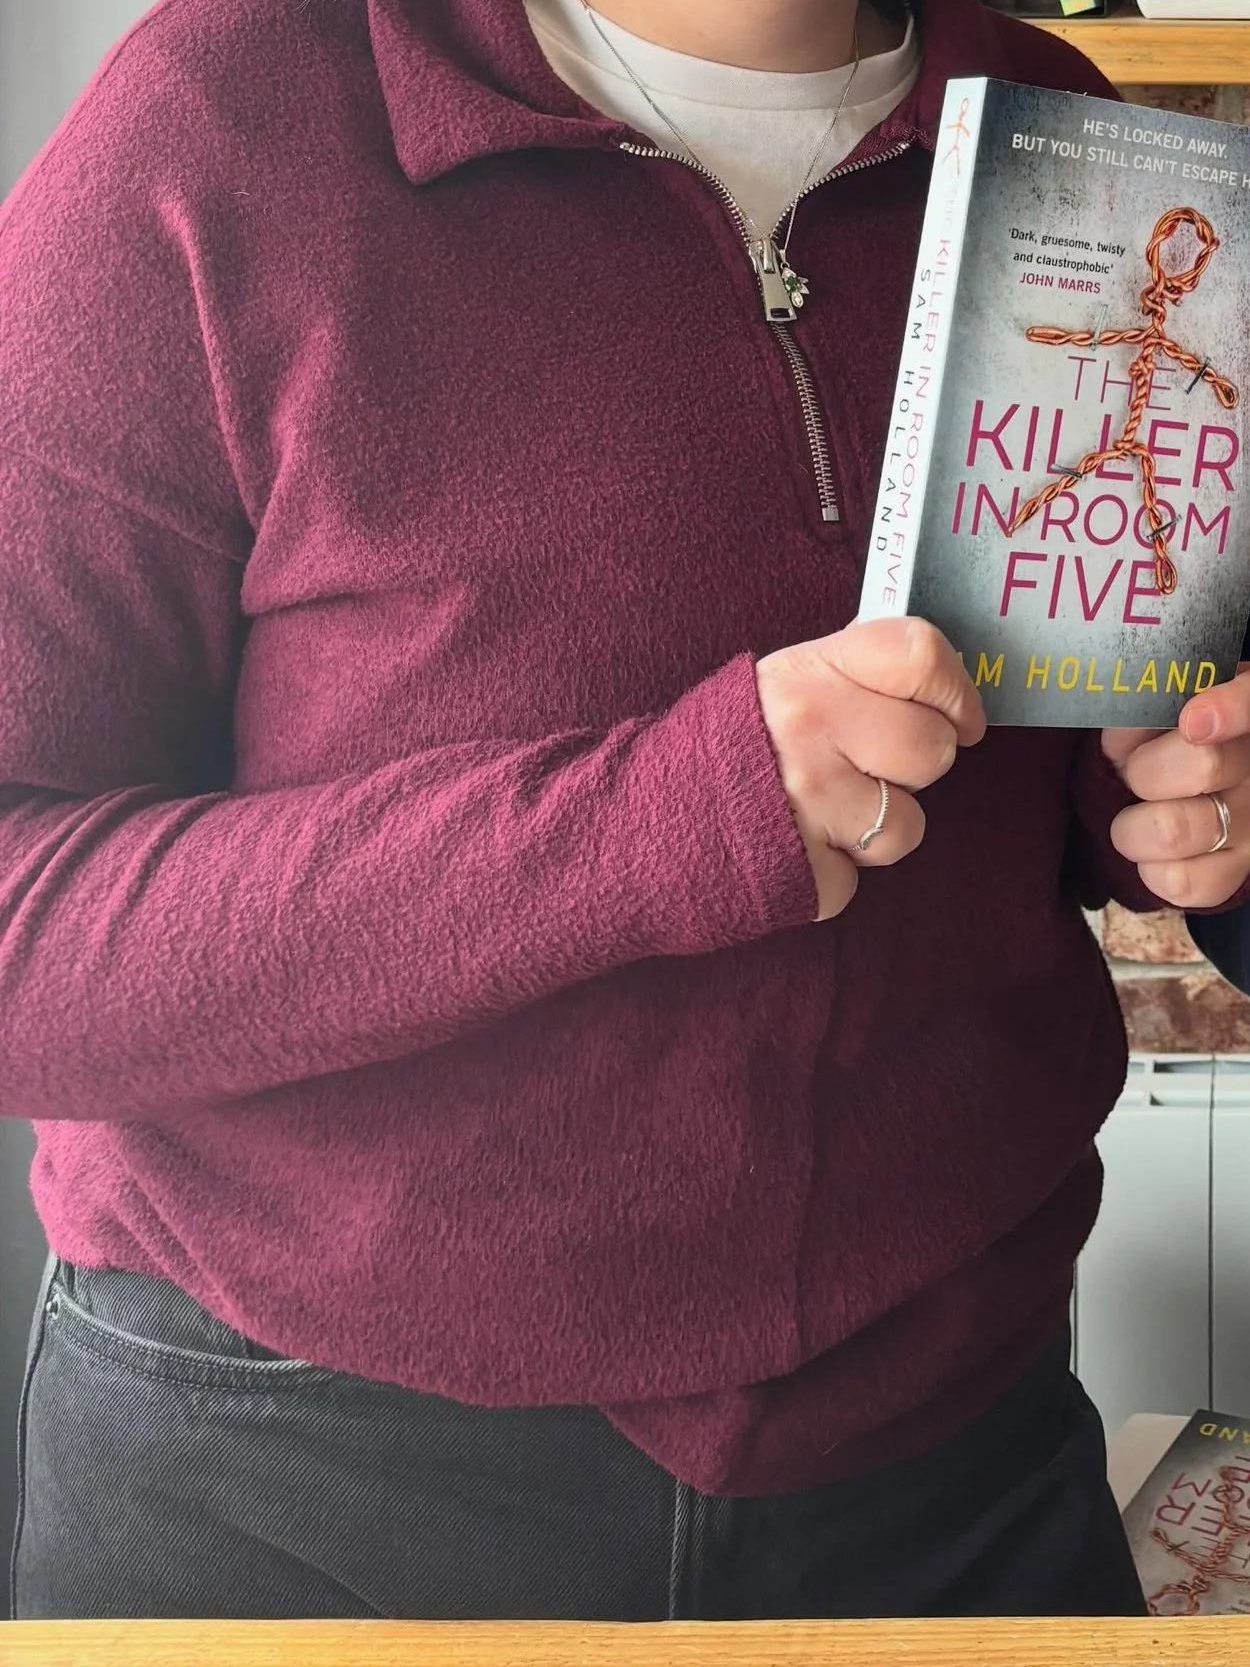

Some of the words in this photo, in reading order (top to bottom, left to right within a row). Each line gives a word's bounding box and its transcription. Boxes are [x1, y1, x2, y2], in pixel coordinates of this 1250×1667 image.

[1011, 133, 1047, 152] BUT
[1051, 139, 1082, 160] YOU
[1087, 146, 1129, 169] STILL
[1133, 155, 1177, 176] CAN'T
[1181, 163, 1237, 188] ESCAPE
[1083, 119, 1119, 139] HE'S
[1123, 127, 1184, 151] LOCKED
[1186, 139, 1228, 160] AWAY.
[1008, 227, 1038, 244] 'Dark,
[1040, 234, 1094, 253] gruesome,
[1096, 241, 1127, 258] twisty
[1013, 251, 1033, 264] and
[1035, 254, 1114, 276] claustrophobic'
[911, 269, 931, 340] SAM
[922, 239, 951, 353] KILLER
[1020, 272, 1054, 289] JOHN
[1057, 277, 1102, 294] MARRS
[915, 365, 932, 399] IN
[1067, 355, 1177, 411] THE
[877, 370, 916, 552] HOLLAND
[896, 412, 924, 519] ROOM
[965, 399, 1240, 493] KILLER
[951, 481, 1020, 538] IN
[1040, 493, 1231, 555] ROOM
[882, 532, 906, 607] FIVE
[1000, 551, 1168, 626] FIVE
[1026, 654, 1217, 694] HOLLAND
